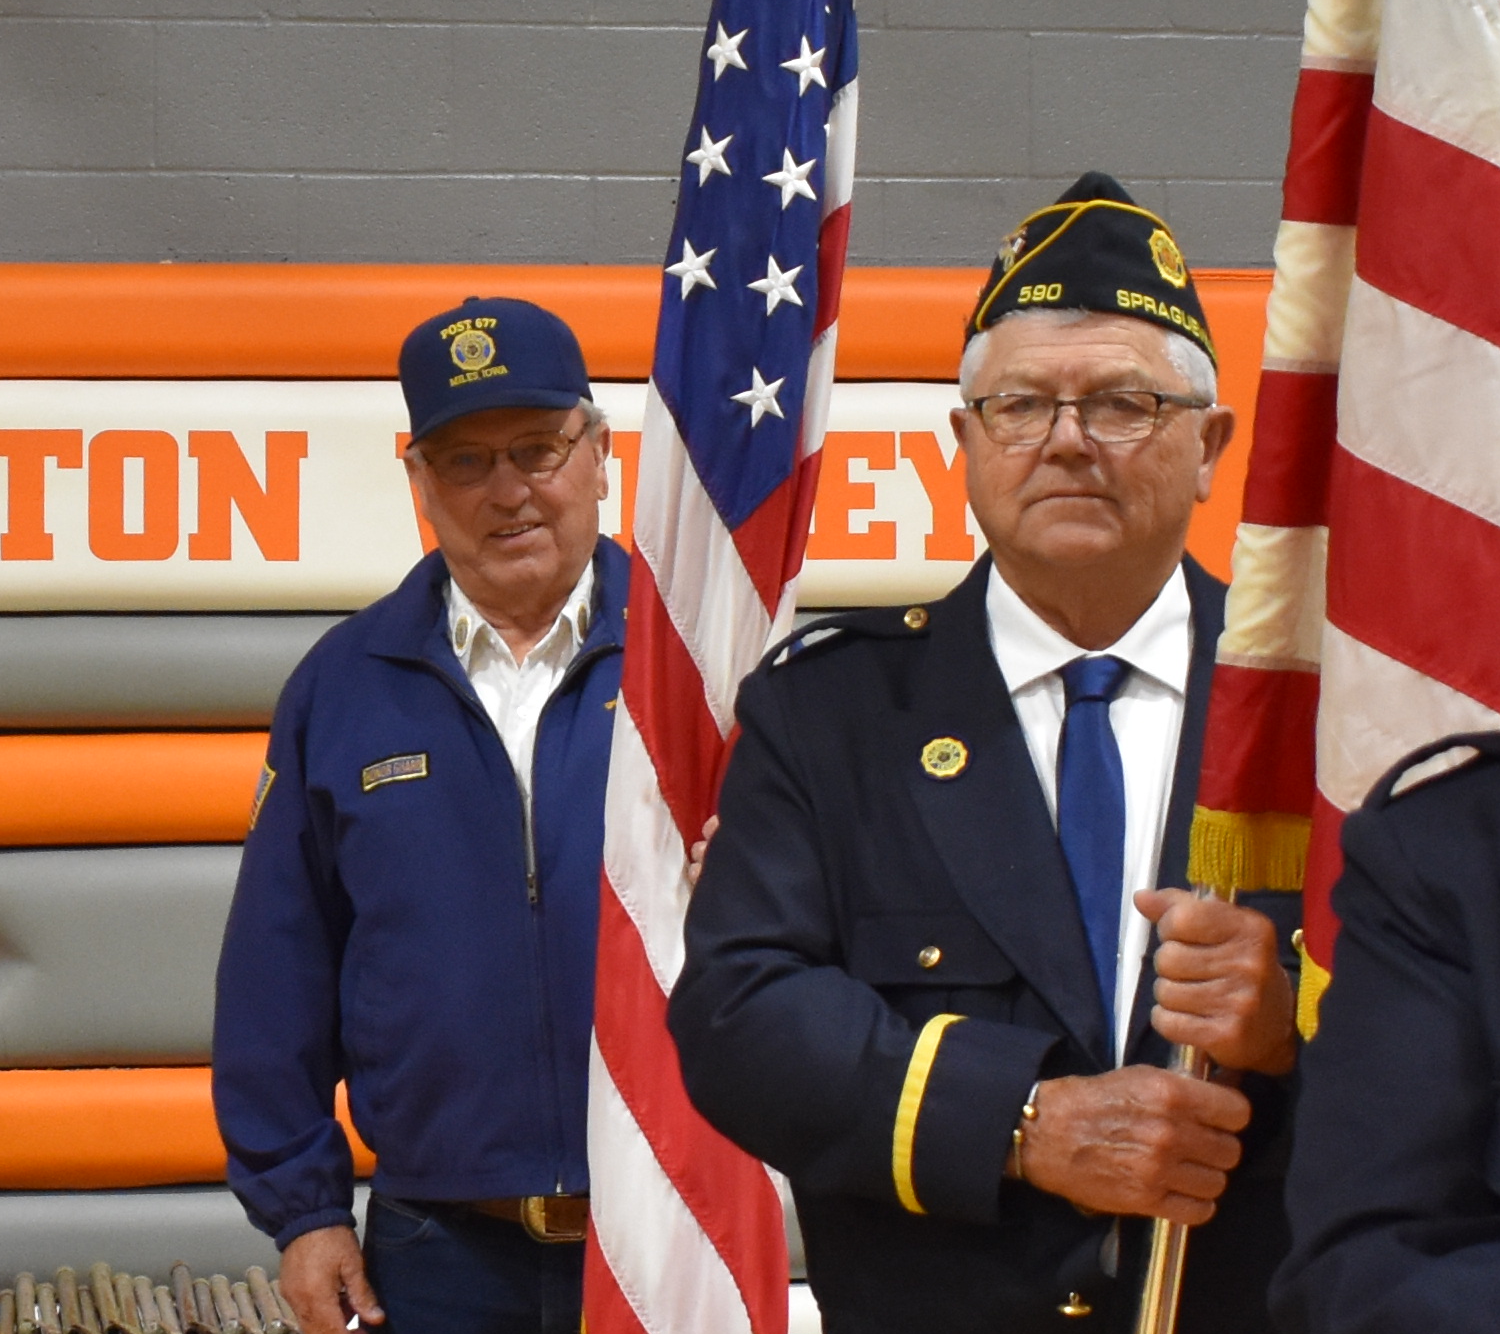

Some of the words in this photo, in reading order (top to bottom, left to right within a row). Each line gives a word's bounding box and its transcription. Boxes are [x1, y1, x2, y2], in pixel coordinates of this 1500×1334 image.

[1016, 282, 1063, 305] 590
[438, 317, 473, 341] POST
[474, 316, 499, 331] 677
[481, 363, 510, 381] IOWA
